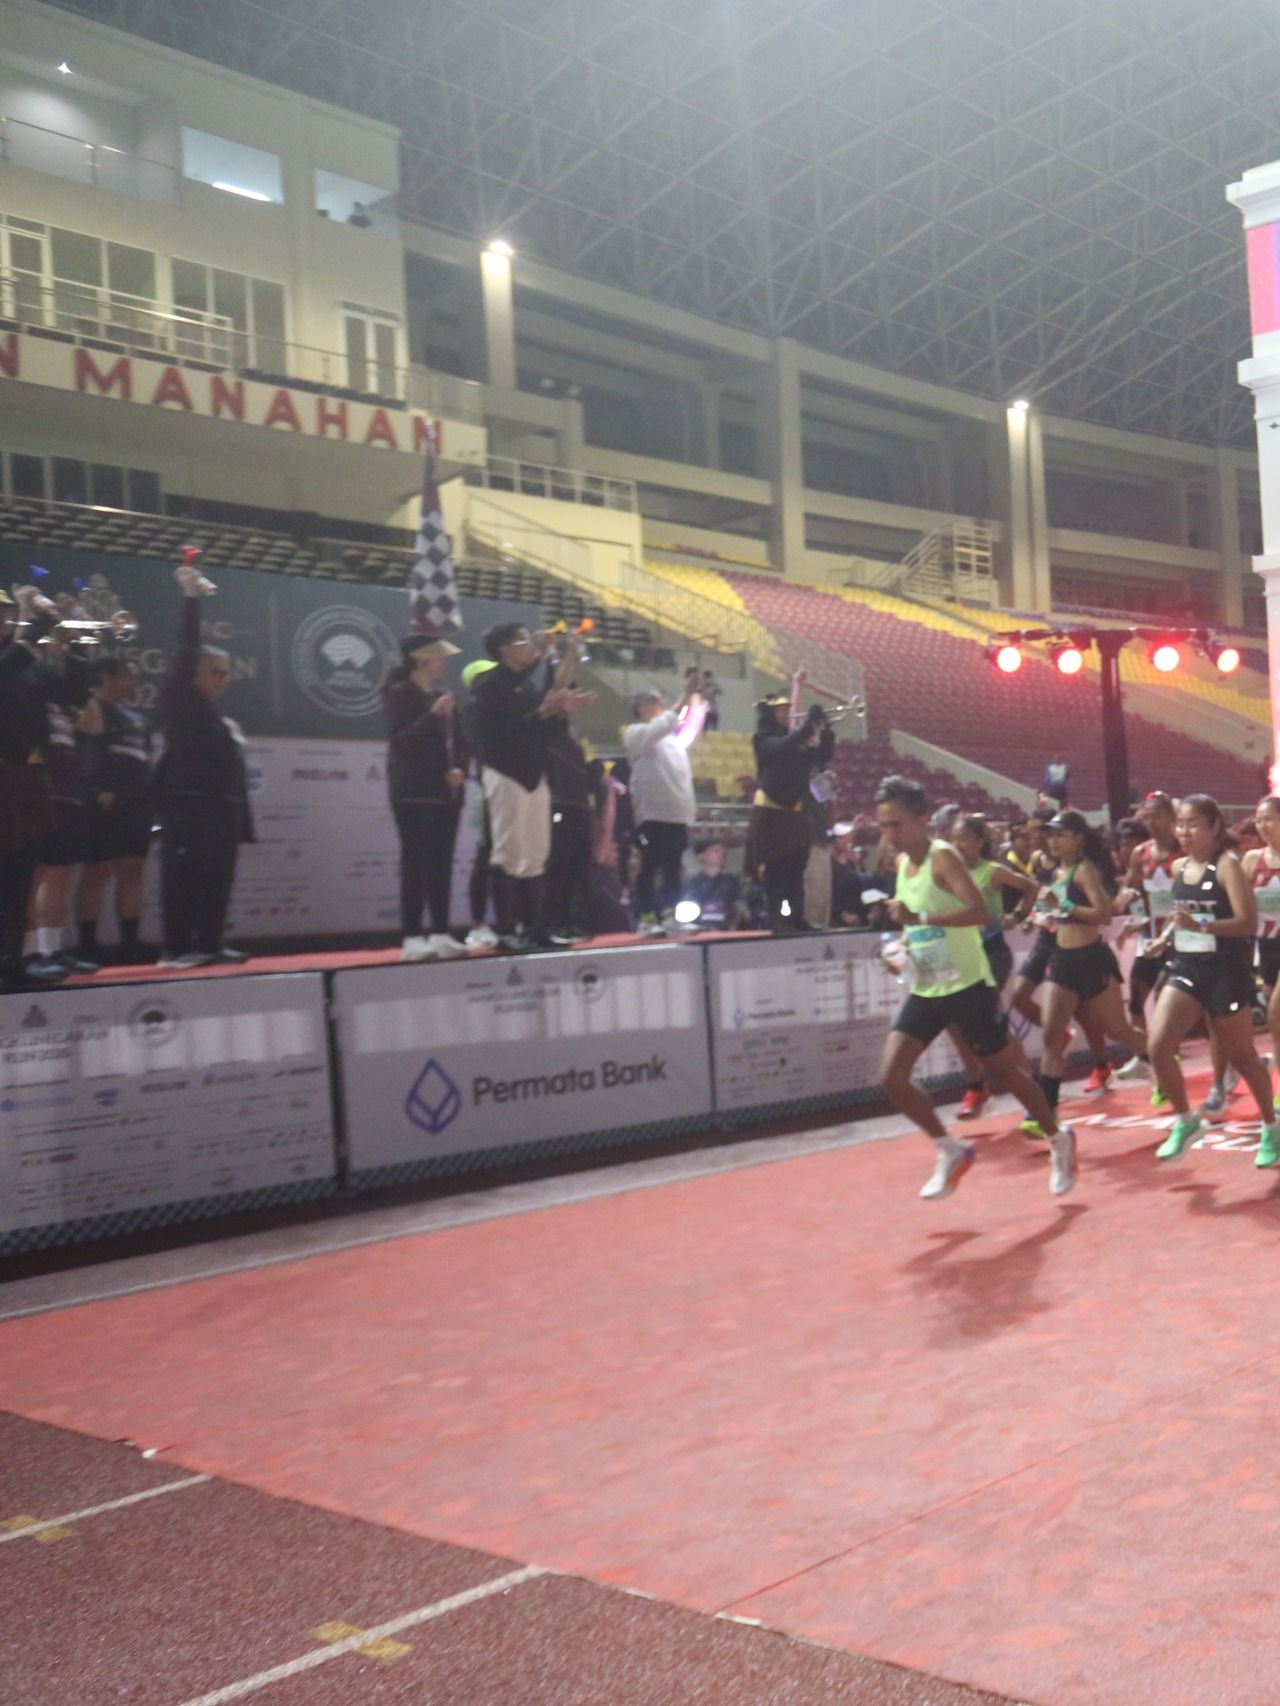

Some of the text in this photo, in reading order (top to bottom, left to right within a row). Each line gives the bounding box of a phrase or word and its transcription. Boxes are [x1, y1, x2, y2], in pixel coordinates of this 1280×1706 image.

[75, 348, 443, 453] MANAHAN
[472, 1056, 668, 1105] Permata Bank
